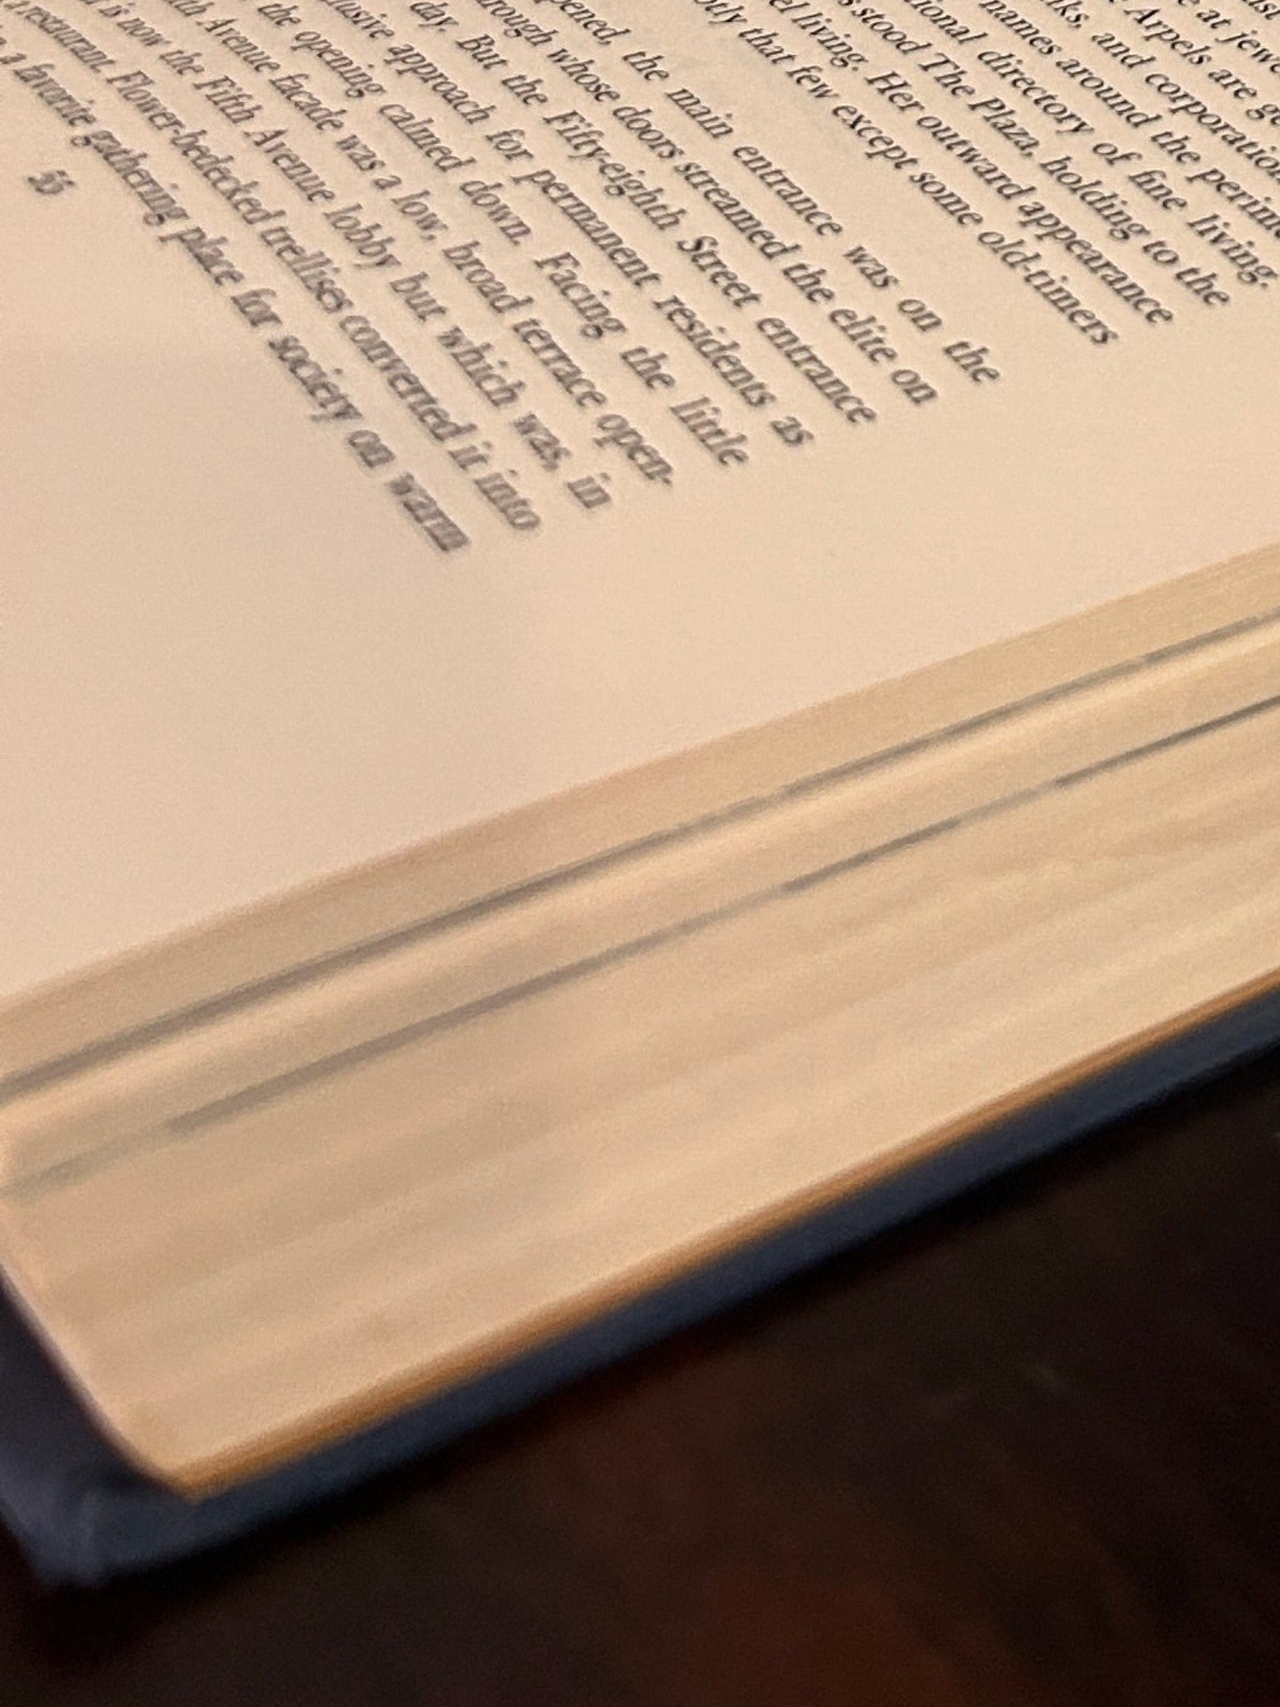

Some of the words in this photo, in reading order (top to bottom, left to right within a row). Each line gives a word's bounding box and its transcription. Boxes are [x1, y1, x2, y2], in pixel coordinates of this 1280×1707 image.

[1054, 57, 1164, 130] around
[1122, 8, 1213, 67] Arpels
[540, 110, 684, 233] Fifty-eighth
[674, 235, 763, 310] Street
[754, 317, 878, 427] entrance
[662, 87, 735, 141] main
[731, 145, 844, 238] entrance
[841, 243, 900, 291] was
[671, 161, 794, 263] streamed
[827, 308, 899, 366] elite
[830, 104, 920, 171] except
[907, 171, 984, 229] some
[976, 230, 1119, 347] old-timers
[864, 70, 925, 114] Her
[915, 115, 1038, 204] outward
[1016, 201, 1175, 326] appearance
[965, 96, 1041, 160] Plaza,
[1037, 155, 1152, 242] holding
[1172, 266, 1231, 307] the
[976, 50, 1096, 136] directory
[1125, 169, 1189, 212] fine
[1184, 213, 1280, 290] living.
[440, 239, 535, 318] broad
[508, 317, 608, 411] terrace
[512, 153, 663, 292] permanent
[650, 294, 778, 411] residents
[531, 254, 629, 338] Facing
[667, 394, 750, 468] little
